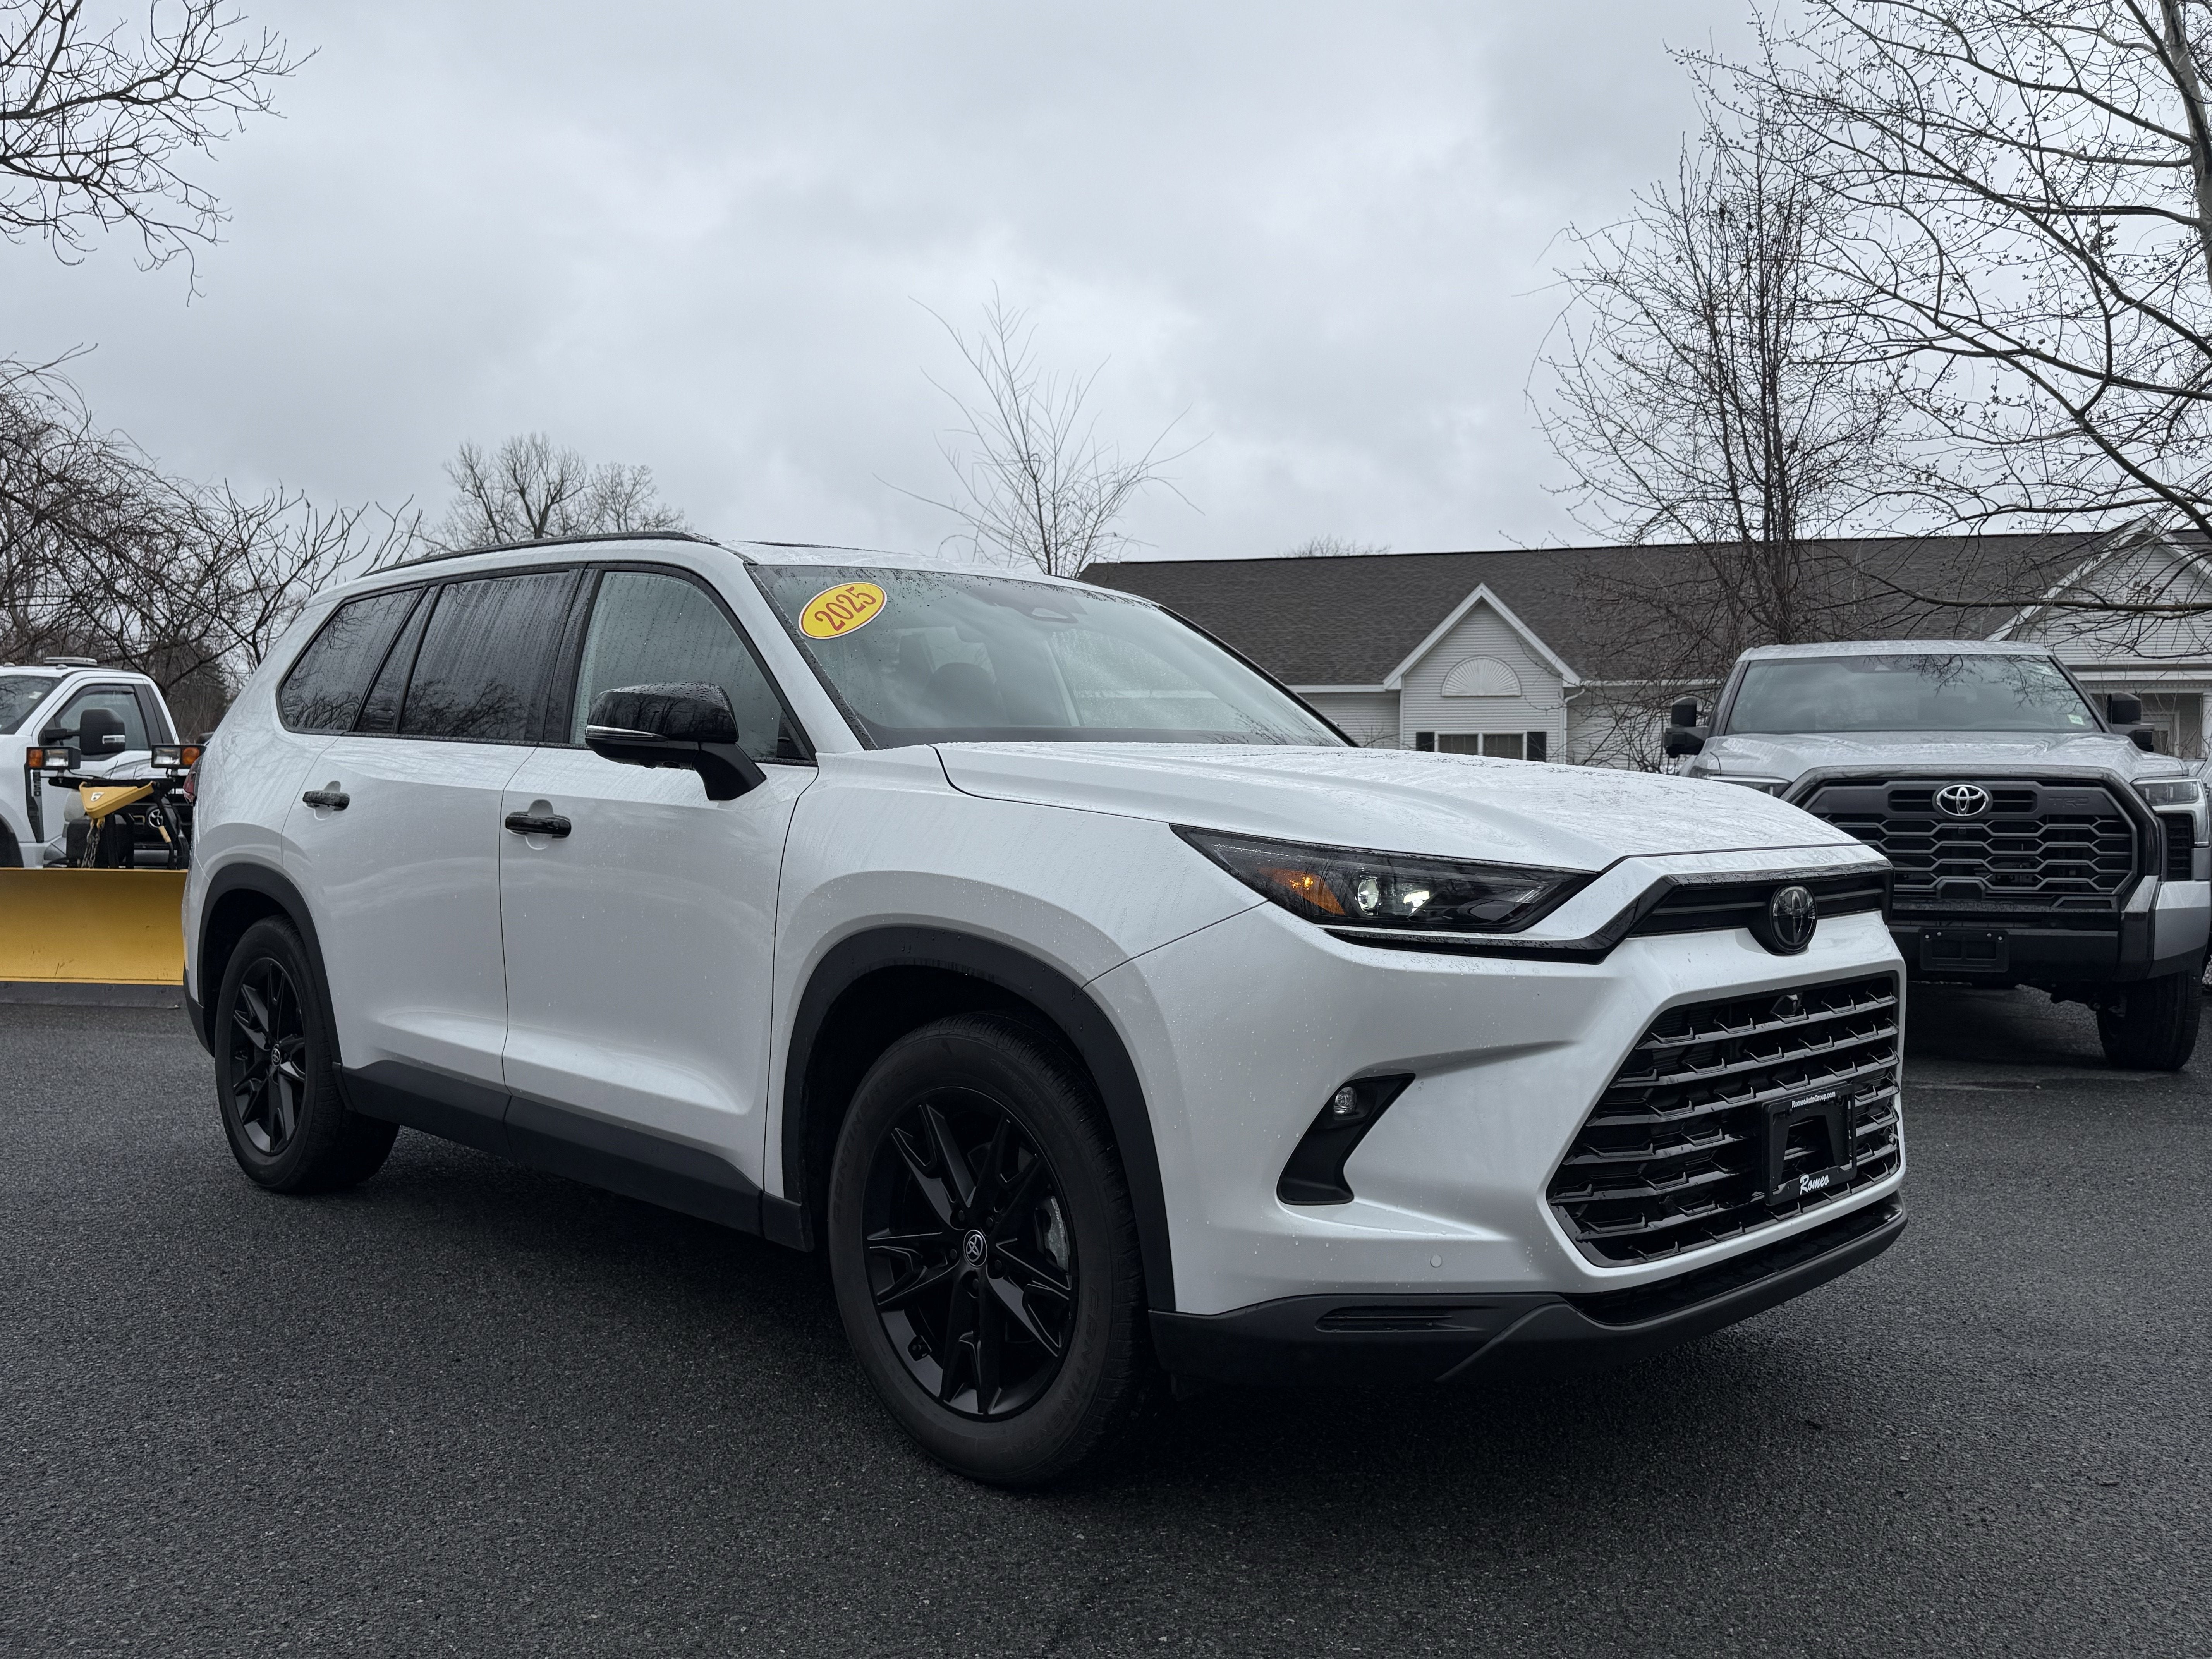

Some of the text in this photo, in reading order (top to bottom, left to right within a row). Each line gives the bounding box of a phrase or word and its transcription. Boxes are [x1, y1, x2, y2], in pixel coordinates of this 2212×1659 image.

[814, 586, 876, 631] 2025
[1791, 1091, 1836, 1108] RomeoAutoGroup.com
[1800, 1174, 1830, 1195] Romeo
